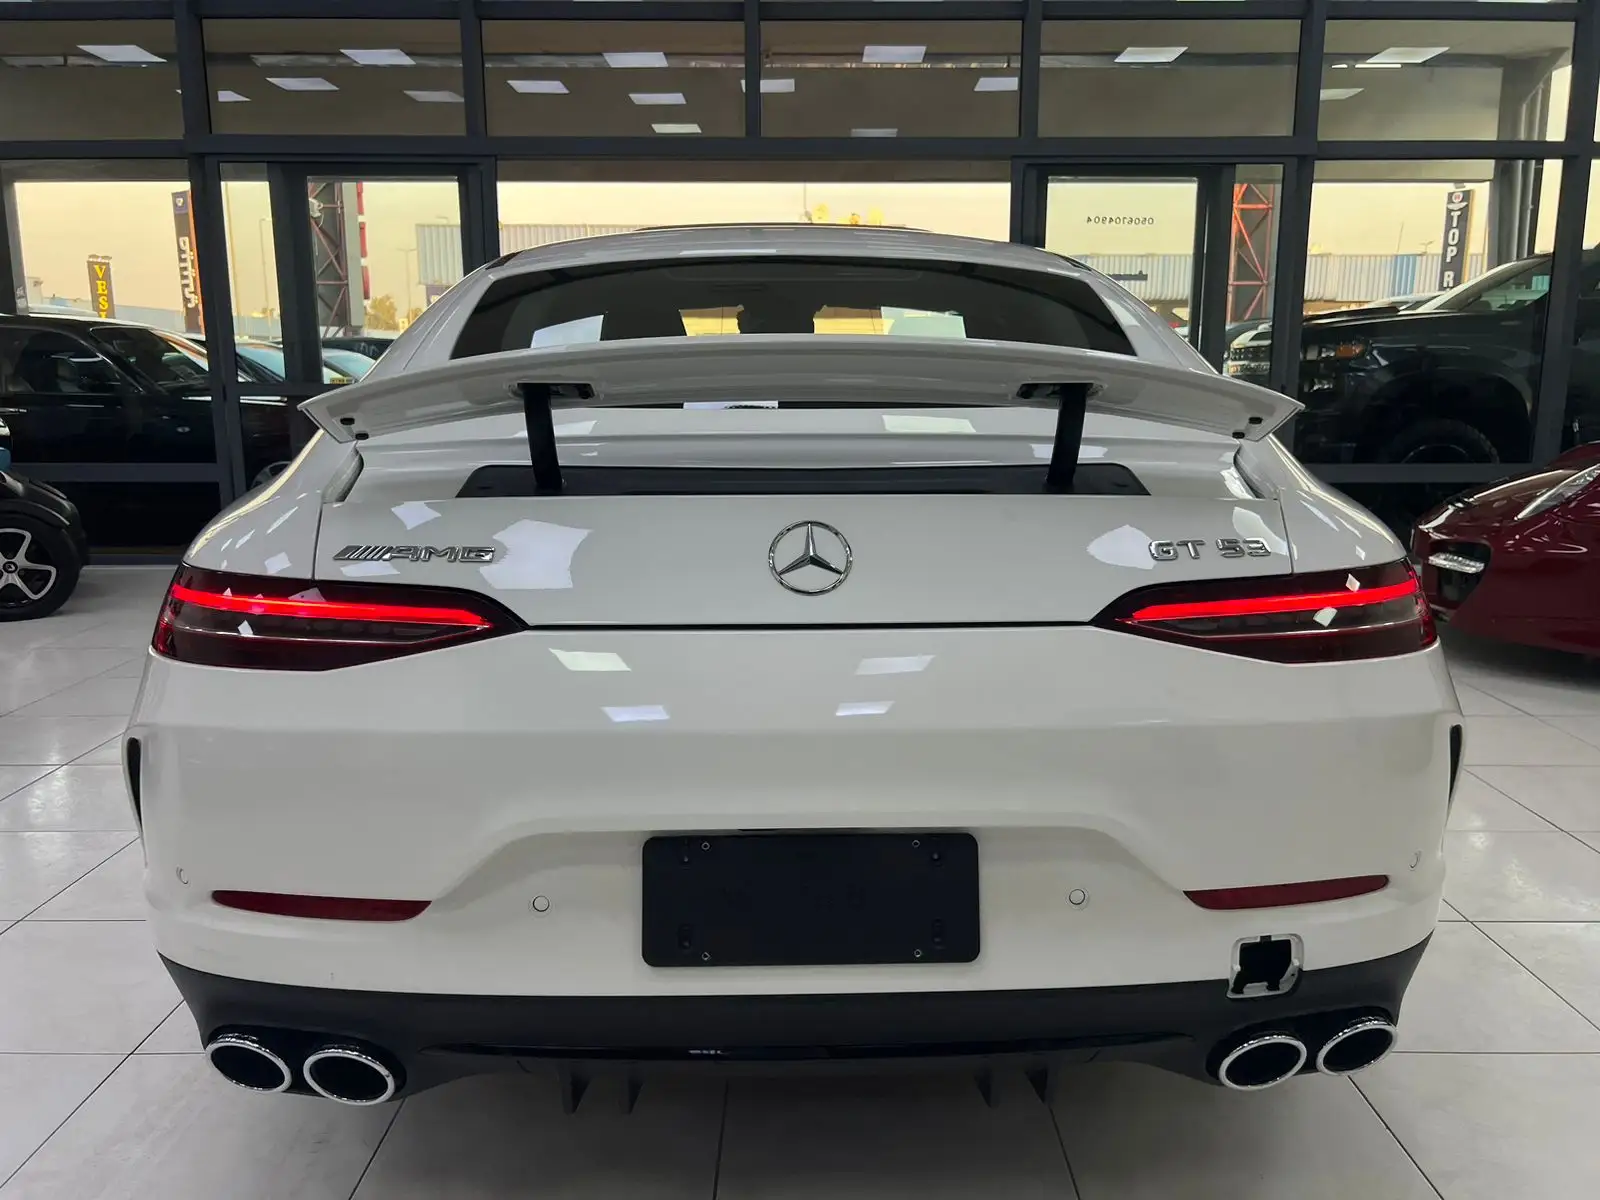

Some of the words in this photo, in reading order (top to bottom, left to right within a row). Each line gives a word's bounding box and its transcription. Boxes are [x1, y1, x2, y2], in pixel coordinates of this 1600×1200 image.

[1446, 210, 1461, 263] TOP
[381, 545, 495, 563] AMG
[1148, 539, 1206, 561] GT
[1216, 537, 1272, 558] 53
